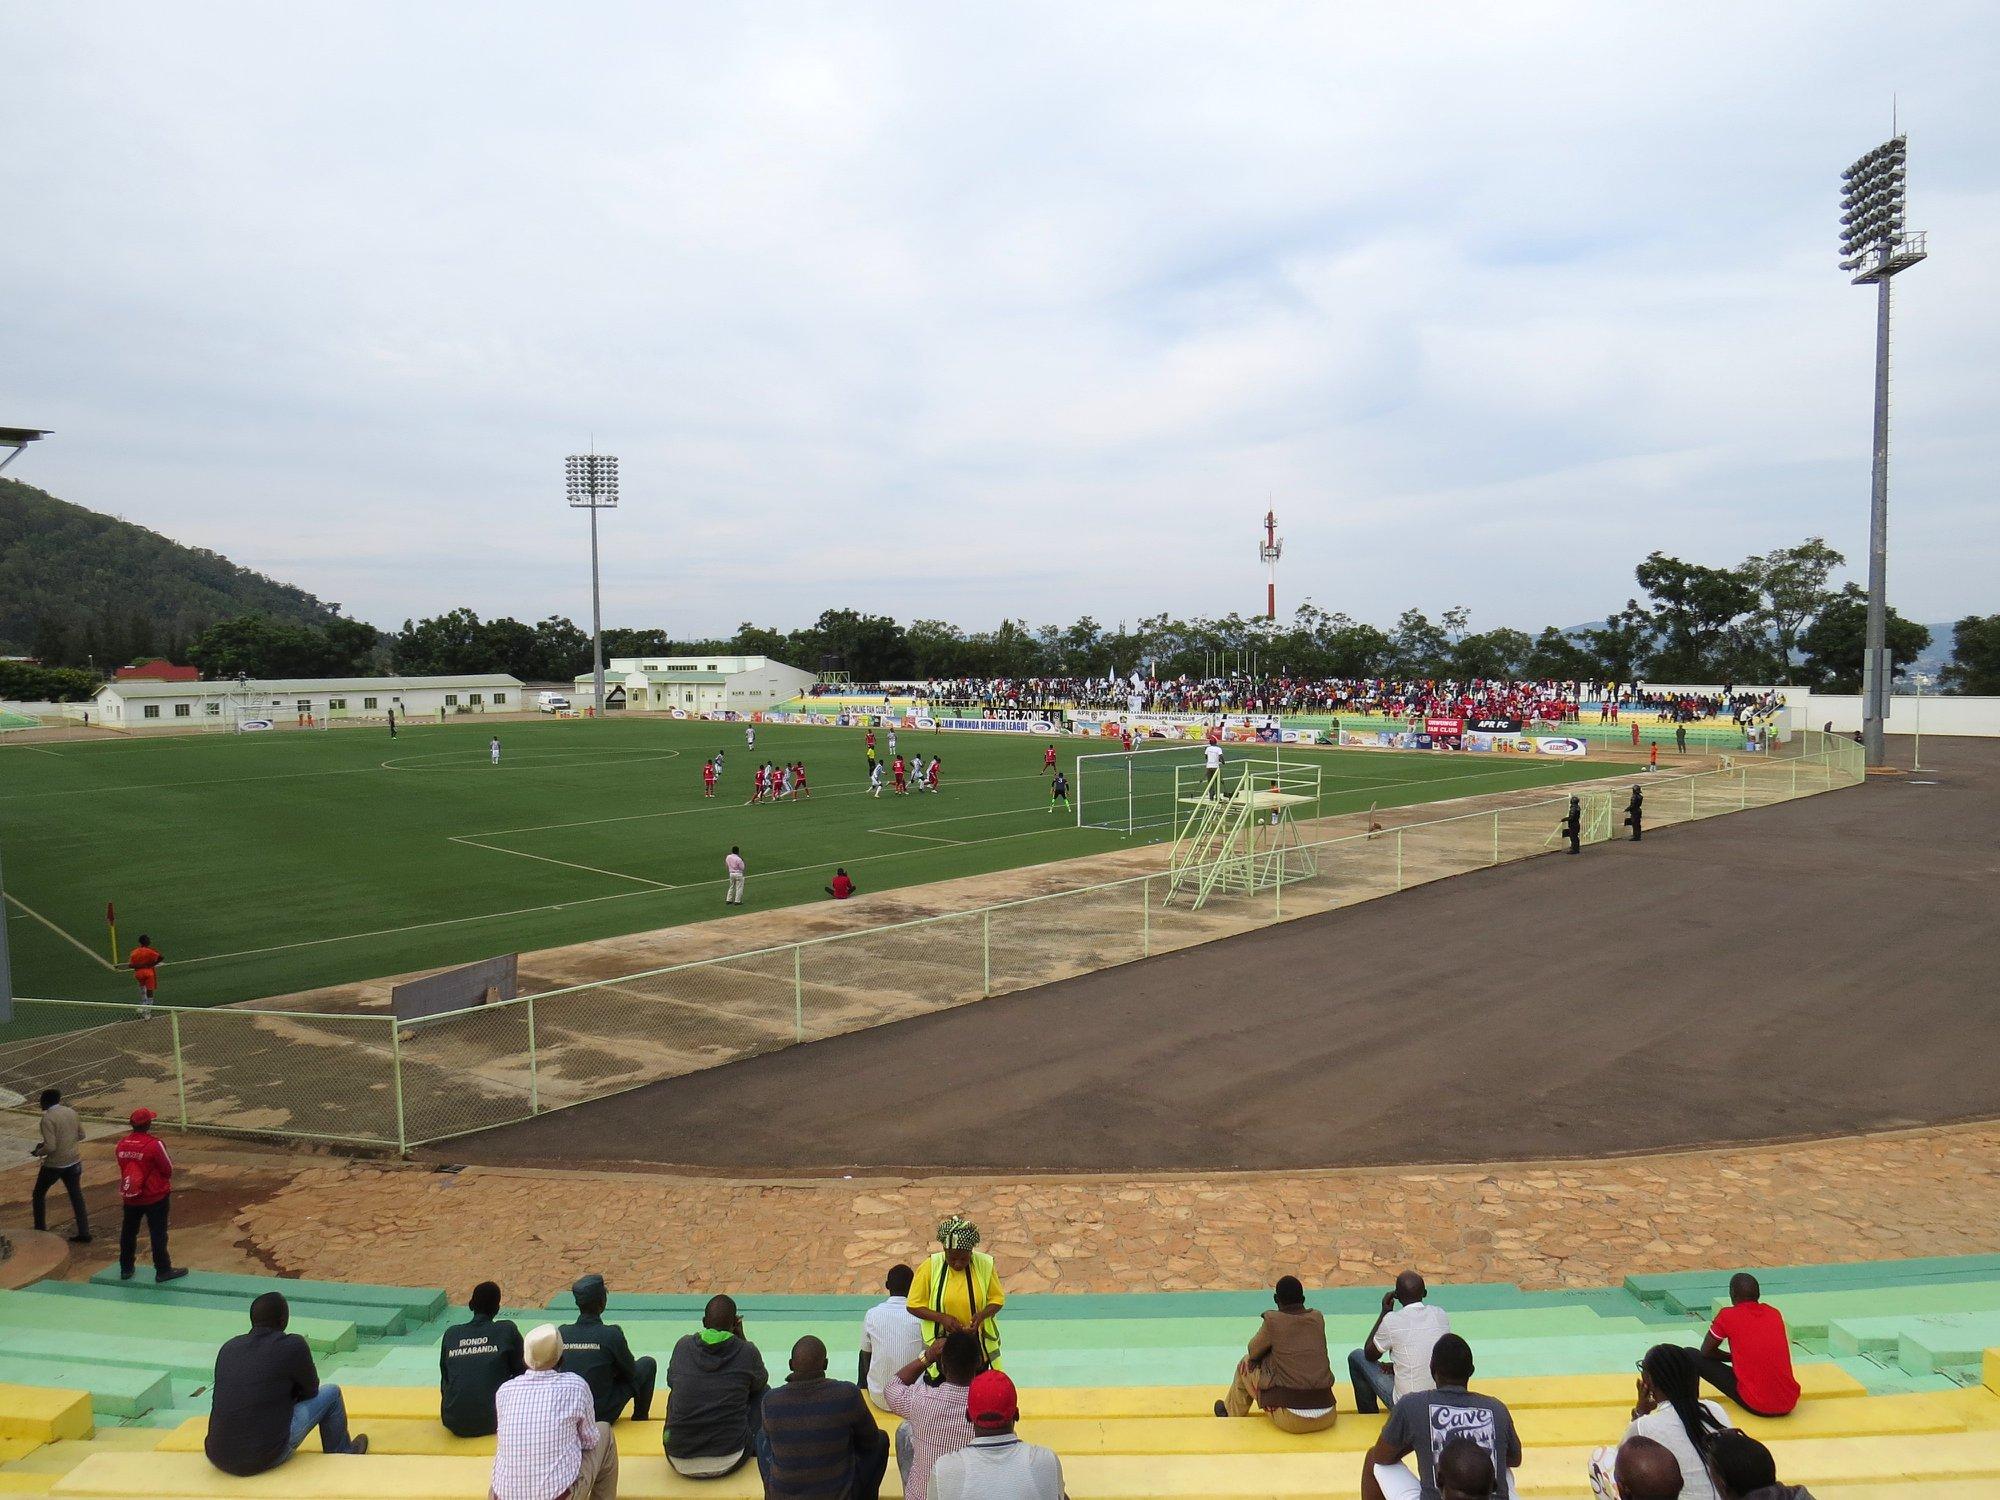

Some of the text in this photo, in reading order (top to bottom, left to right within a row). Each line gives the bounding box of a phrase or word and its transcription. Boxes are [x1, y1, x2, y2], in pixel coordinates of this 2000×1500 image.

[993, 709, 1007, 720] APR
[1009, 710, 1020, 720] FC
[1021, 710, 1044, 722] ZONE
[941, 719, 1028, 731] ZAM RWANDA PREMIER LEAGUE
[1478, 720, 1509, 729] APR FC
[459, 1336, 488, 1347] IRONDO
[448, 1345, 499, 1358] NYAKABANDA
[1431, 1407, 1492, 1430] Cave
